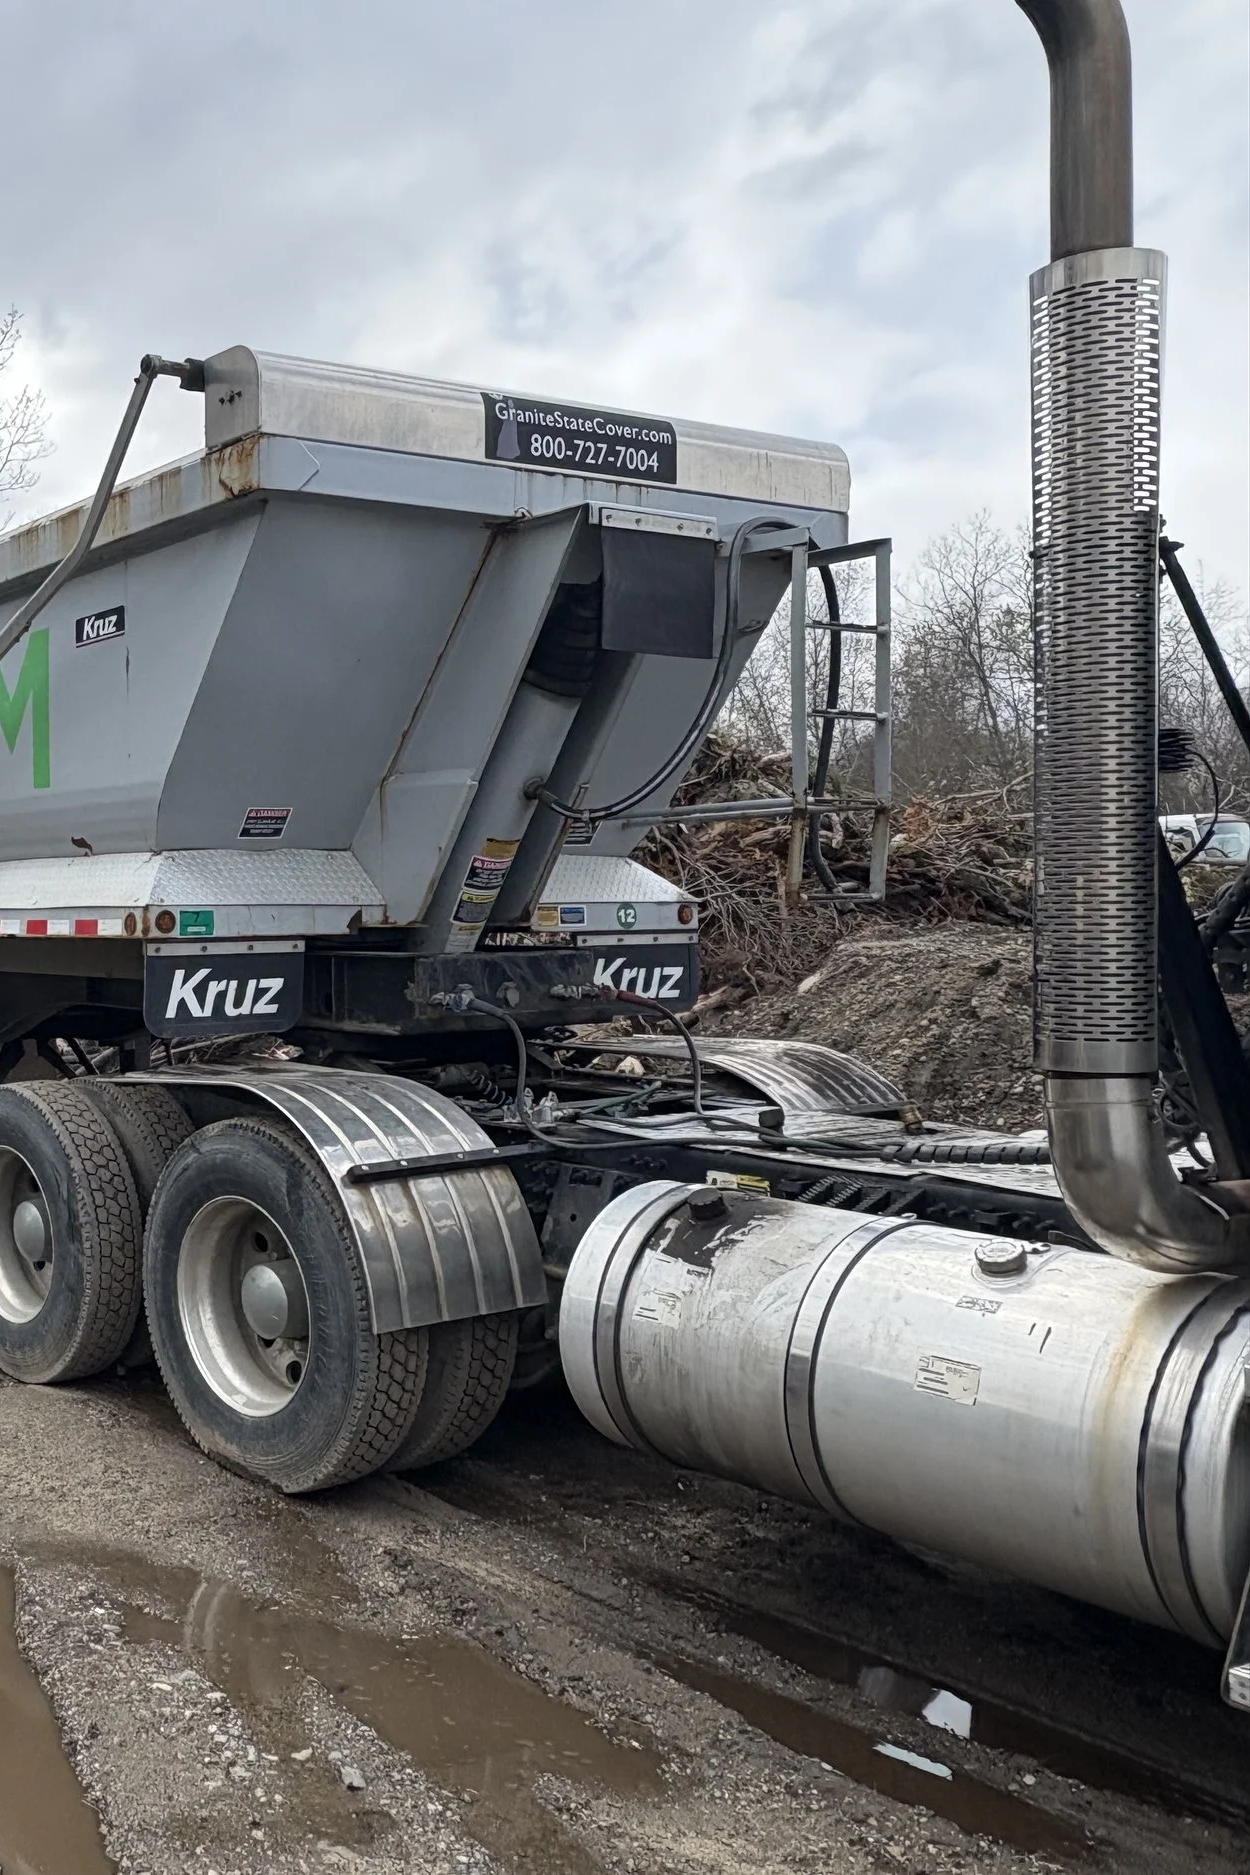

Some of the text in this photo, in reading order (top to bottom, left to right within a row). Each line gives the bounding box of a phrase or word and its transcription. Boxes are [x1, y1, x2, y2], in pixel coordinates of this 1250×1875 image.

[495, 401, 673, 446] GraniteStateCover.com
[530, 432, 660, 473] 800-727-7004
[83, 614, 118, 641] Kruz
[617, 909, 636, 923] 12
[165, 967, 285, 1020] Kruz
[593, 957, 684, 999] Kruz
